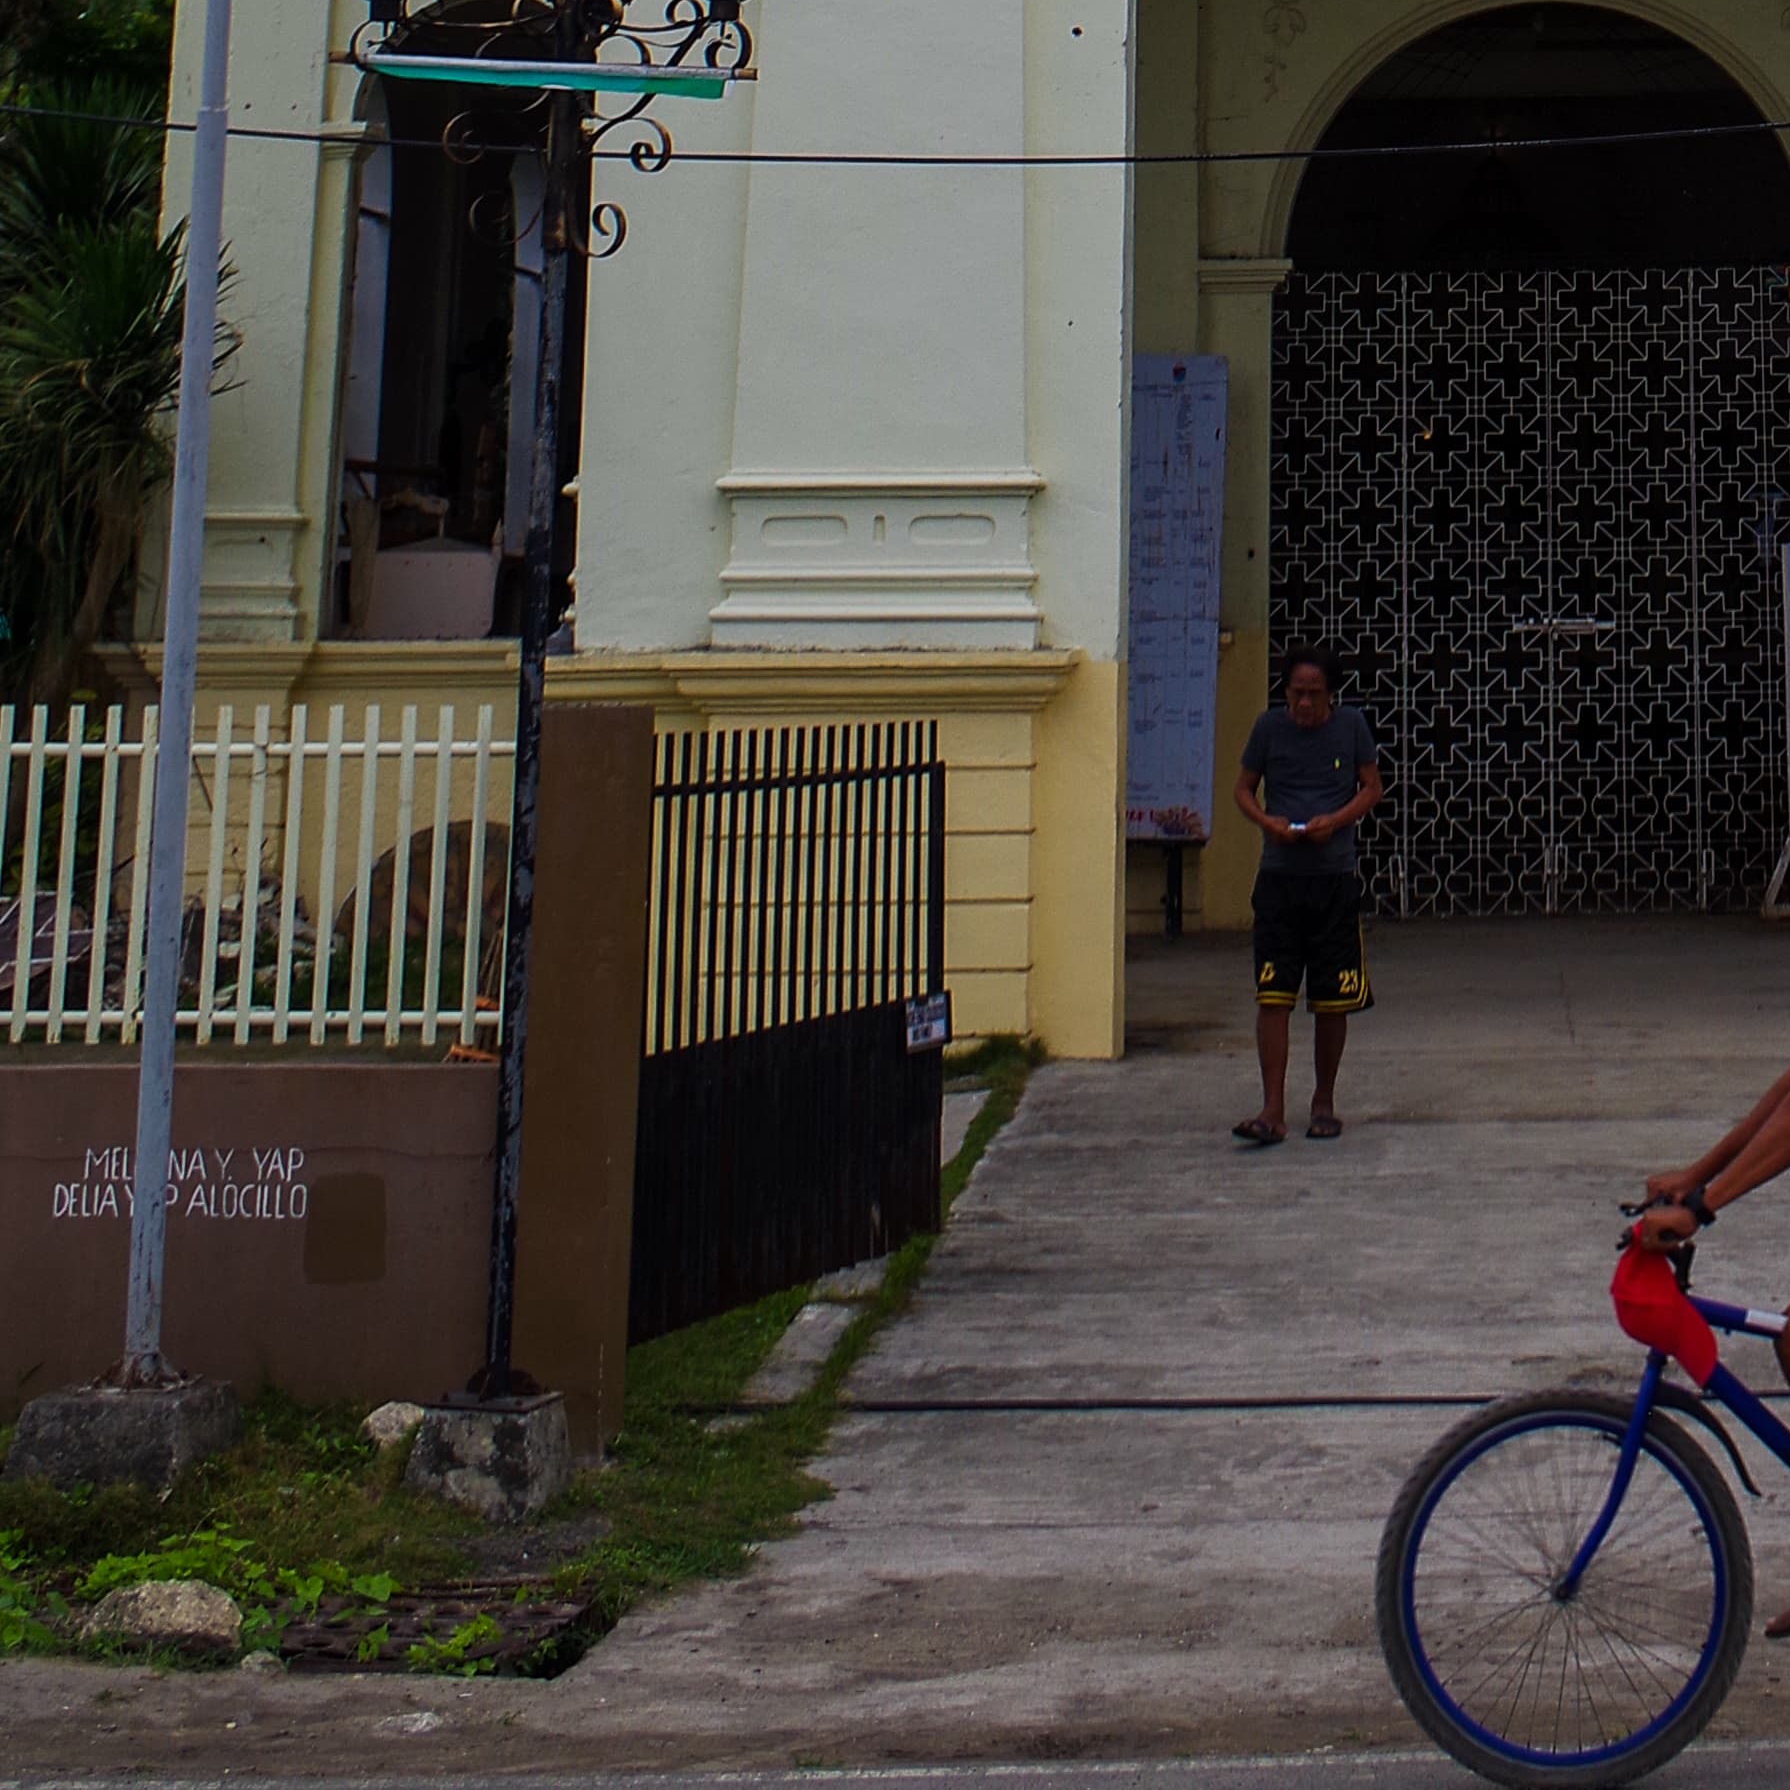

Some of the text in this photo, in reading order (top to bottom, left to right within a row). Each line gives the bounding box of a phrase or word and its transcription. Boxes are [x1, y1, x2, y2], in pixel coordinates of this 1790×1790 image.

[1339, 969, 1359, 994] 23
[214, 1147, 235, 1181] Y.
[253, 1147, 305, 1182] YAP
[53, 1183, 308, 1219] DELIA YP ALOCILLO
